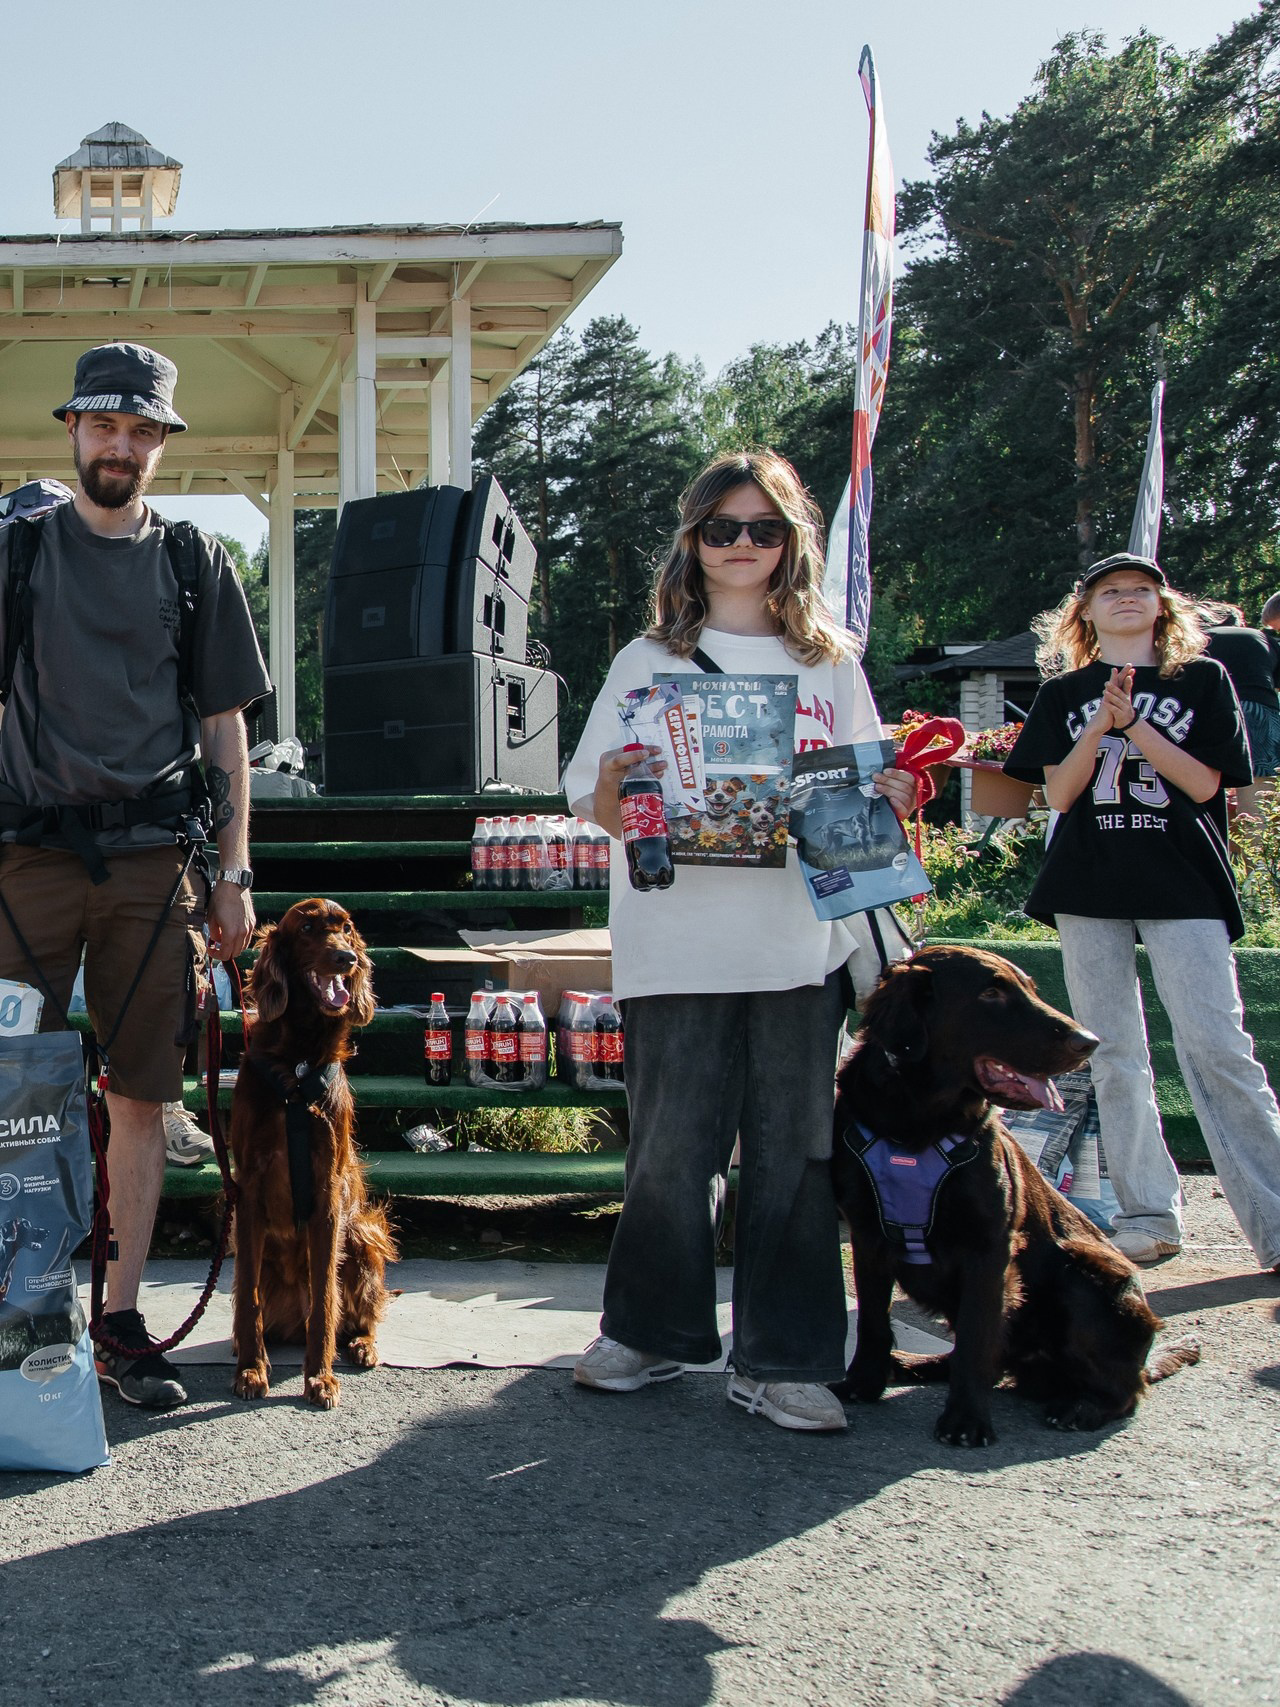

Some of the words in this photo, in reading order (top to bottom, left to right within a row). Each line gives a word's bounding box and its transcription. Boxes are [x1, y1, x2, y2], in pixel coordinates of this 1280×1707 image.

[66, 394, 123, 410] PUMA
[1066, 692, 1195, 744] CHOSE
[668, 708, 695, 785] СЕРТИФИКАТ
[718, 743, 727, 754] 3
[790, 767, 849, 788] -SPORT
[1092, 735, 1171, 809] 73
[1095, 814, 1125, 830] THE
[1131, 814, 1168, 832] BEST
[36, 1136, 62, 1145] СОБАК
[0, 1179, 13, 1195] 3
[23, 1178, 60, 1188] ФИЗИЧЕСКОЙ
[24, 1186, 52, 1194] НАГРУЗКИ
[28, 1272, 72, 1284] ОТЕЧЕСТВЕННОЕ
[28, 1278, 72, 1290] ПРОИЗВОДСТВО
[28, 1353, 72, 1367] ХОЛИСТИК
[38, 1393, 50, 1402] 10
[51, 1392, 62, 1400] кг
